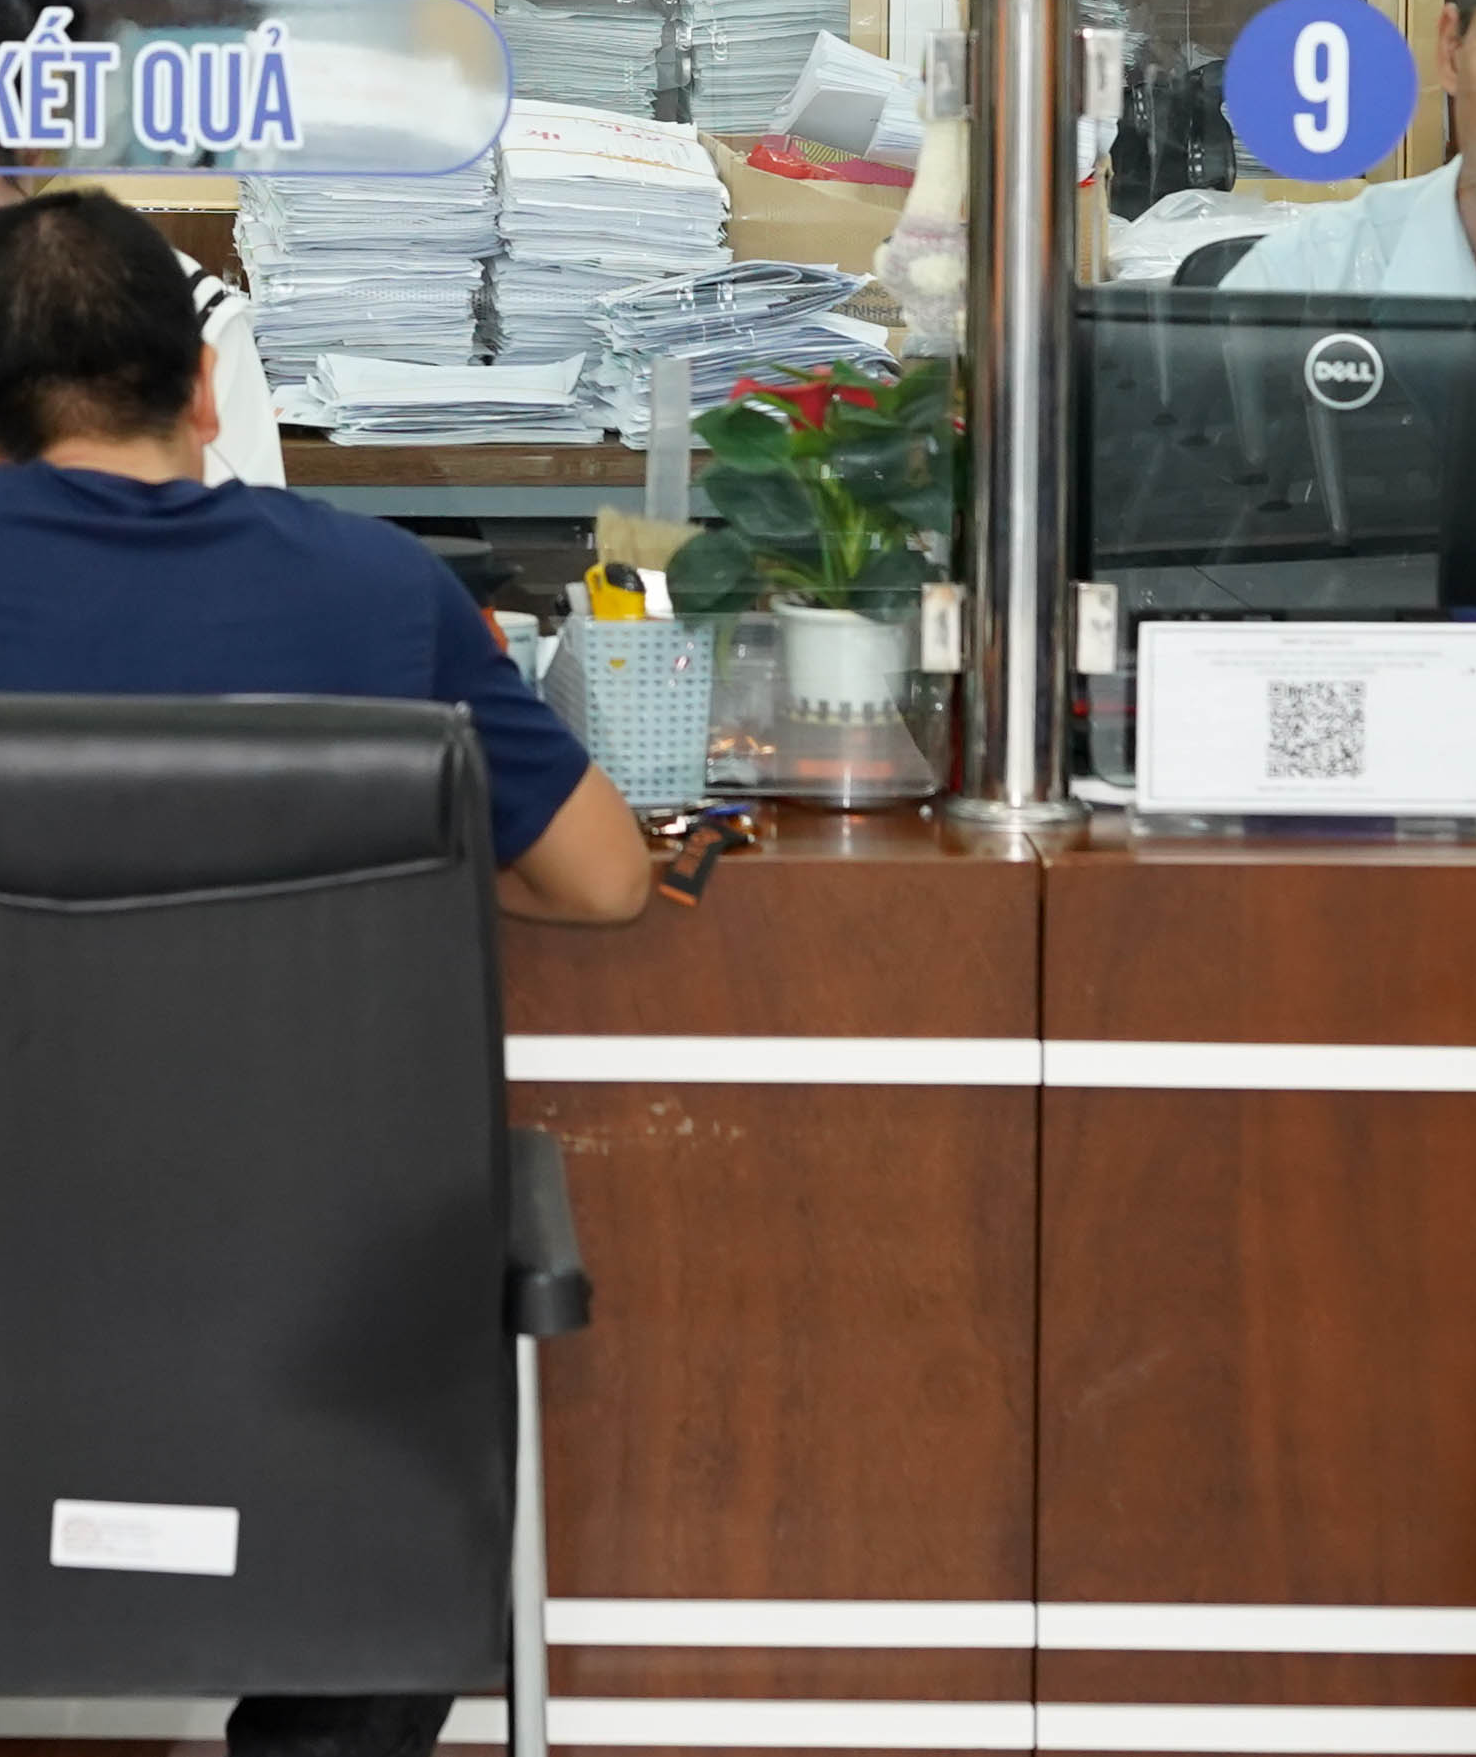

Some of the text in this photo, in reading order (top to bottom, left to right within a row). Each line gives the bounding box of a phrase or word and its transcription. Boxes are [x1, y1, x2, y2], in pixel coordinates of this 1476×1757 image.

[132, 18, 303, 155] QUẢ
[1291, 19, 1351, 154] 9
[1314, 360, 1376, 382] DELL
